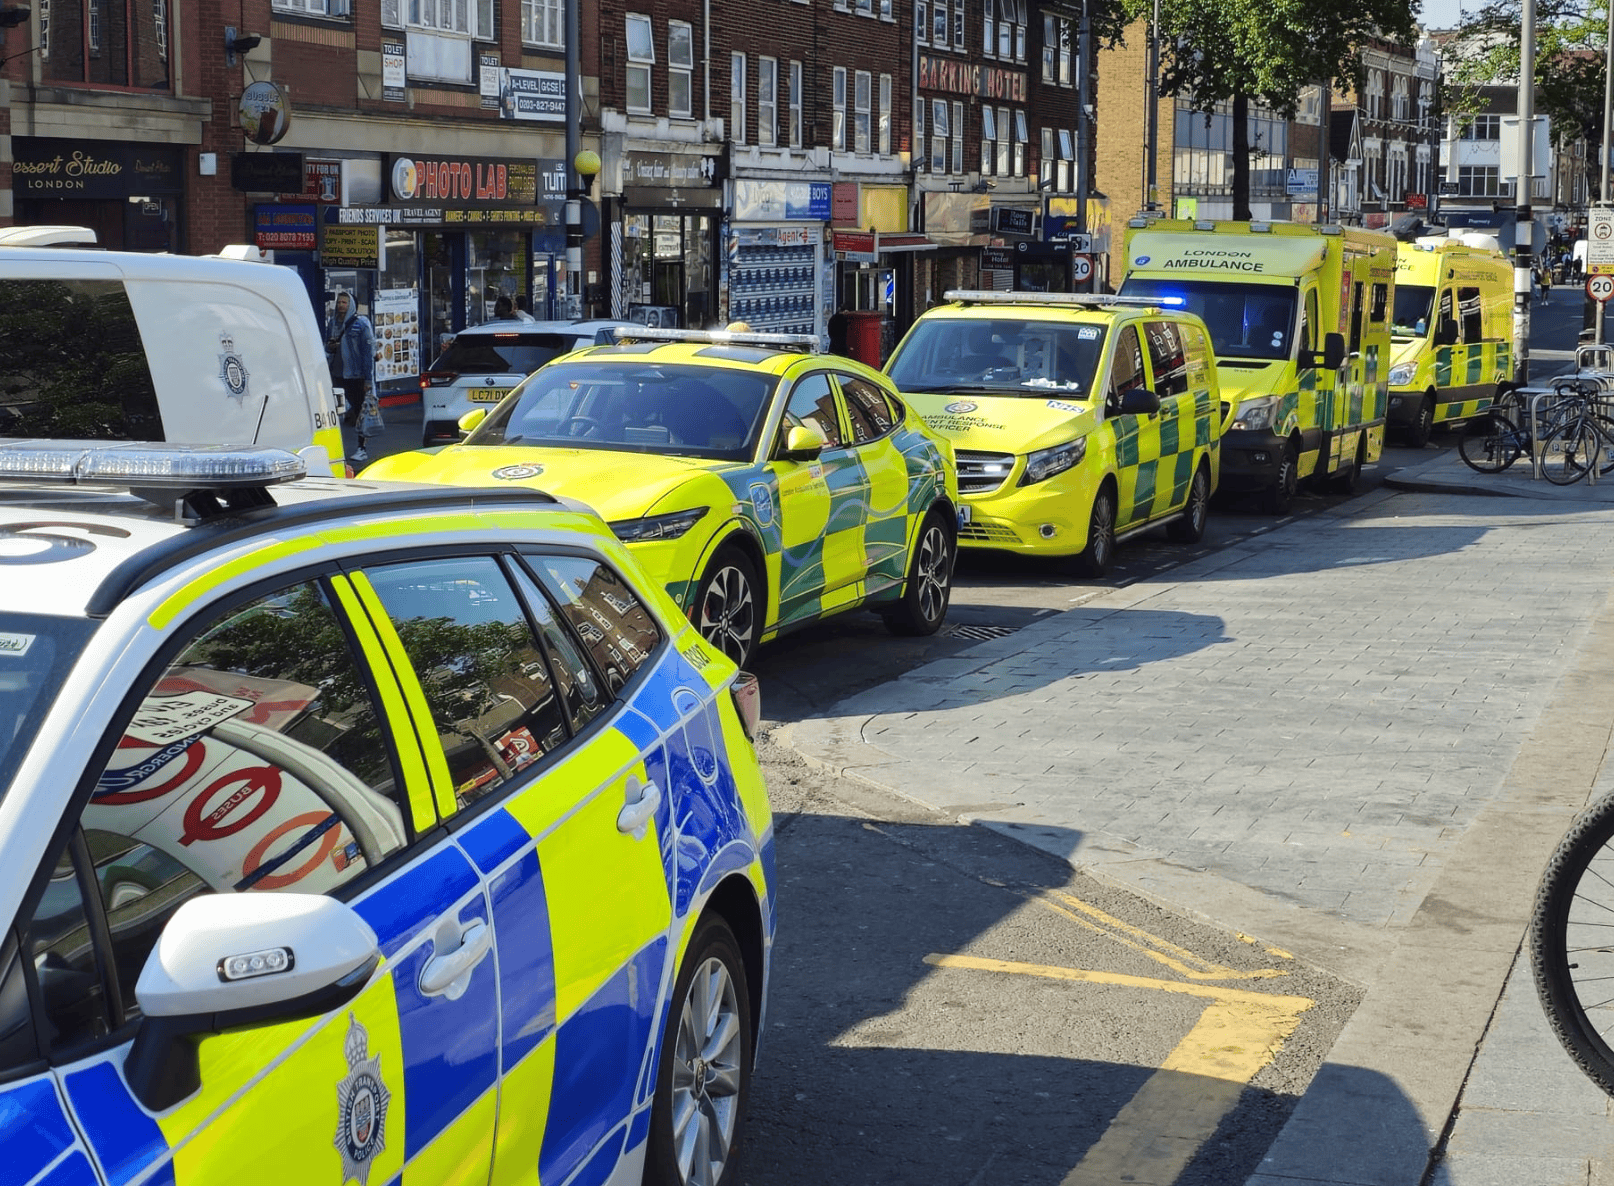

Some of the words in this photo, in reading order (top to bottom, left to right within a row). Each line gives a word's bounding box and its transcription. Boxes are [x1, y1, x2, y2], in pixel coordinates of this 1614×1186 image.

[384, 44, 392, 54] TO
[392, 45, 403, 54] LET
[384, 58, 403, 68] SHOP
[481, 56, 488, 64] TO
[488, 58, 498, 66] LET
[919, 56, 980, 95] BARKING
[987, 69, 1026, 102] HOTEL
[512, 79, 538, 91] A-LEVEL
[541, 81, 559, 92] GCSE
[246, 91, 279, 102] BUBBLE
[13, 155, 64, 174] essert
[65, 150, 122, 176] Studio
[28, 180, 84, 188] LONDON
[414, 160, 472, 199] PHOTO
[476, 163, 507, 200] LAB
[340, 208, 364, 224] FRIENDS
[364, 208, 392, 224] SERVICES
[392, 209, 402, 224] UK
[404, 208, 423, 216] TRAVEL
[424, 209, 442, 217] AGENT
[778, 228, 798, 245] Agent
[1184, 250, 1252, 258] LONDON
[1163, 259, 1264, 272] AMBULANCE
[1592, 282, 1612, 292] 20
[472, 390, 492, 400] LC71
[314, 410, 337, 429] B410
[922, 414, 988, 422] AMBULANCE
[927, 424, 971, 432] OFFICER
[948, 420, 1007, 430] RESPONSE
[356, 1076, 380, 1120] TRANSPORT
[354, 1137, 374, 1160] POLICE
